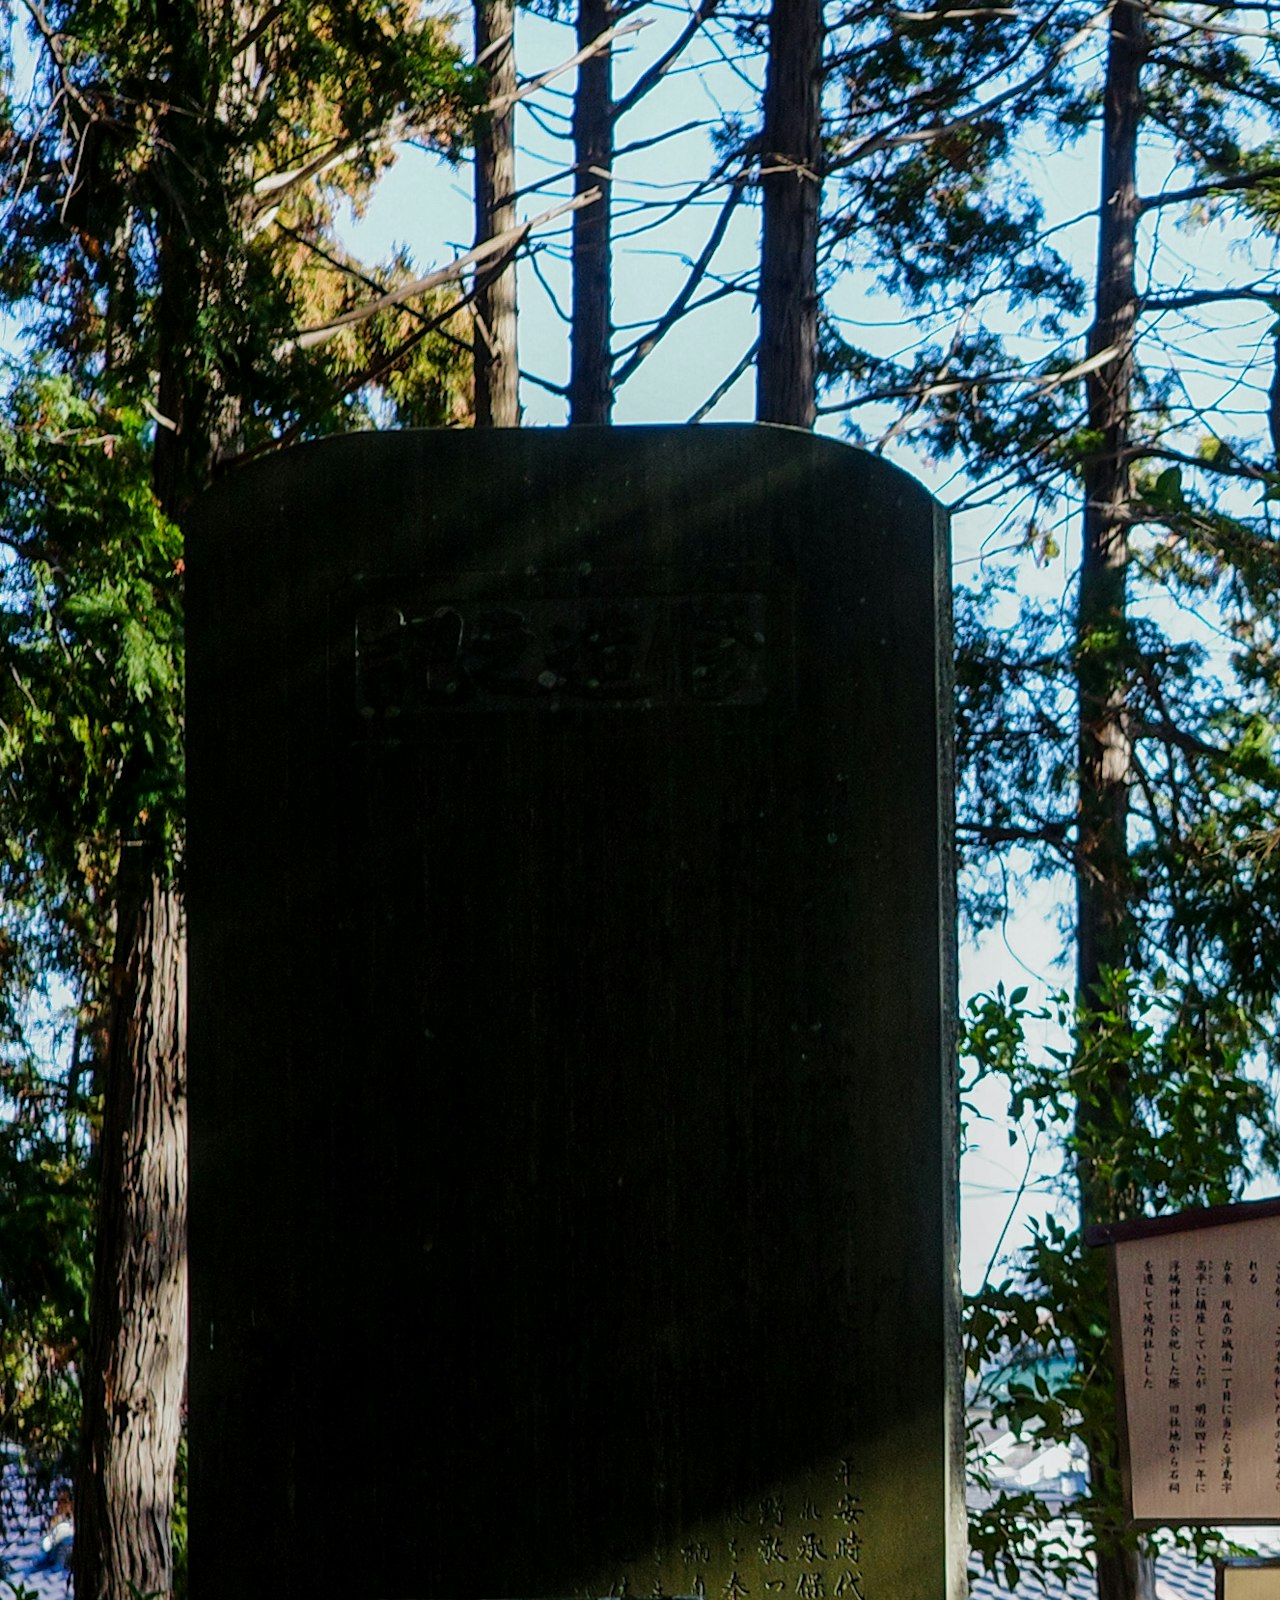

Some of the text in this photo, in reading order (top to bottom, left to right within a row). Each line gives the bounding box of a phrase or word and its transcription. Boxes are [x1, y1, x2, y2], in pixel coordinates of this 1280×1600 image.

[1249, 1261, 1257, 1285] れる
[1194, 1403, 1206, 1493] 明治四十一年に
